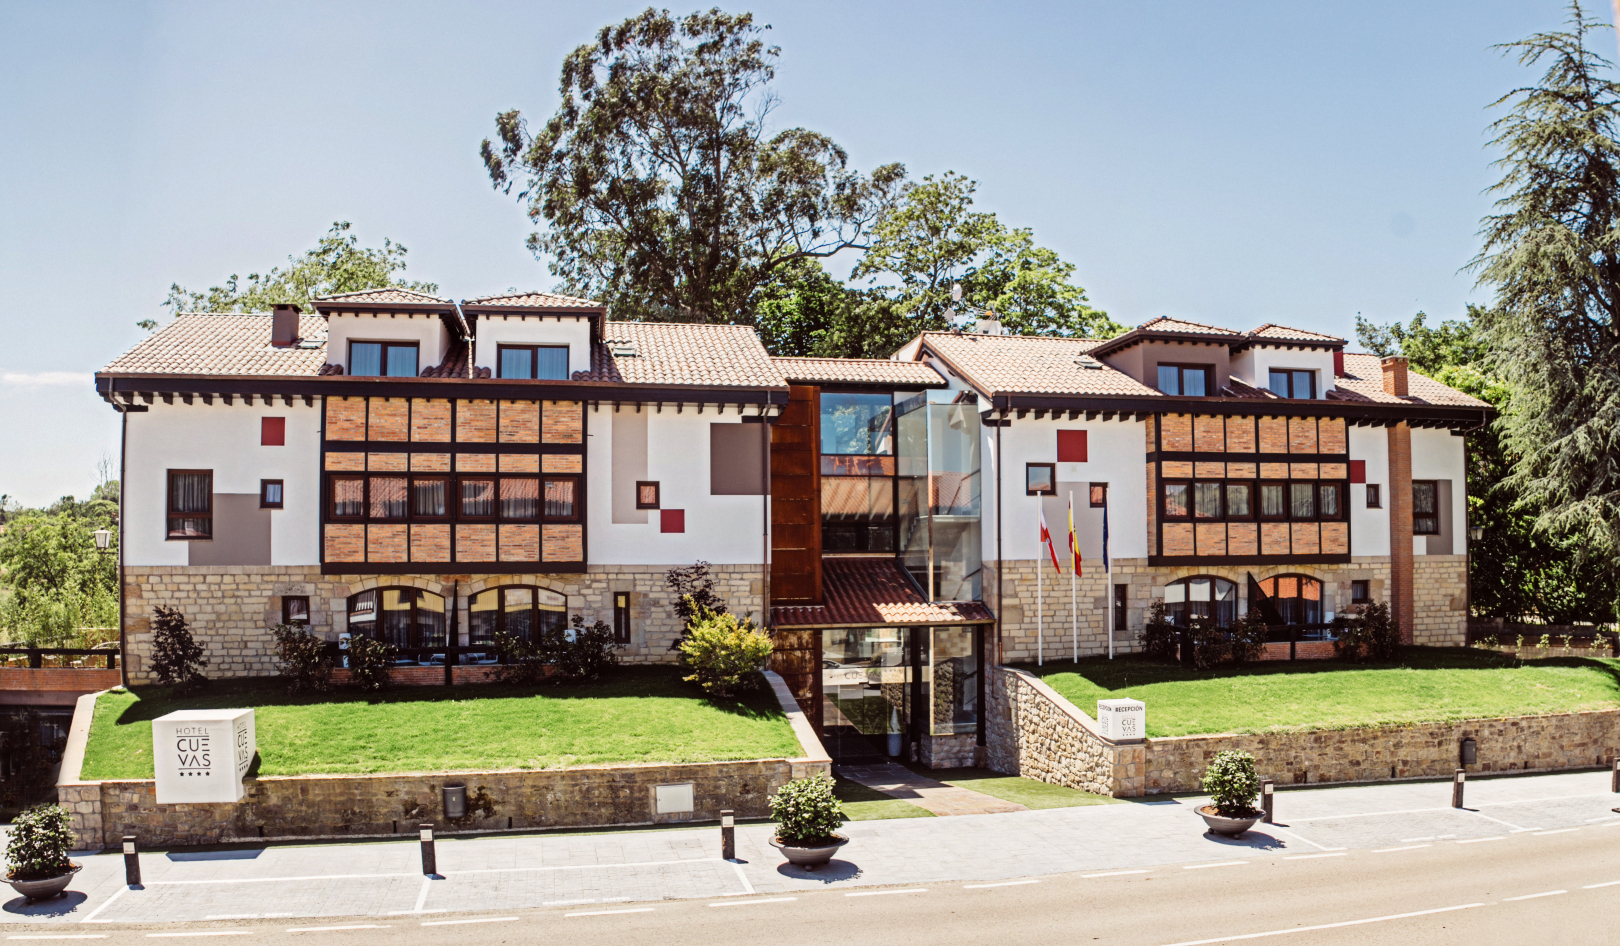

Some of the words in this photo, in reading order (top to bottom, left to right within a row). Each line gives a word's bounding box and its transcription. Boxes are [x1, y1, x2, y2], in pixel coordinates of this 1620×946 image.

[1115, 705, 1143, 713] RECEPCIÓN
[176, 727, 209, 735] HOTEL
[177, 738, 210, 752] CUE
[238, 731, 248, 748] CUE
[178, 753, 211, 767] VAS
[238, 746, 249, 761] VAS
